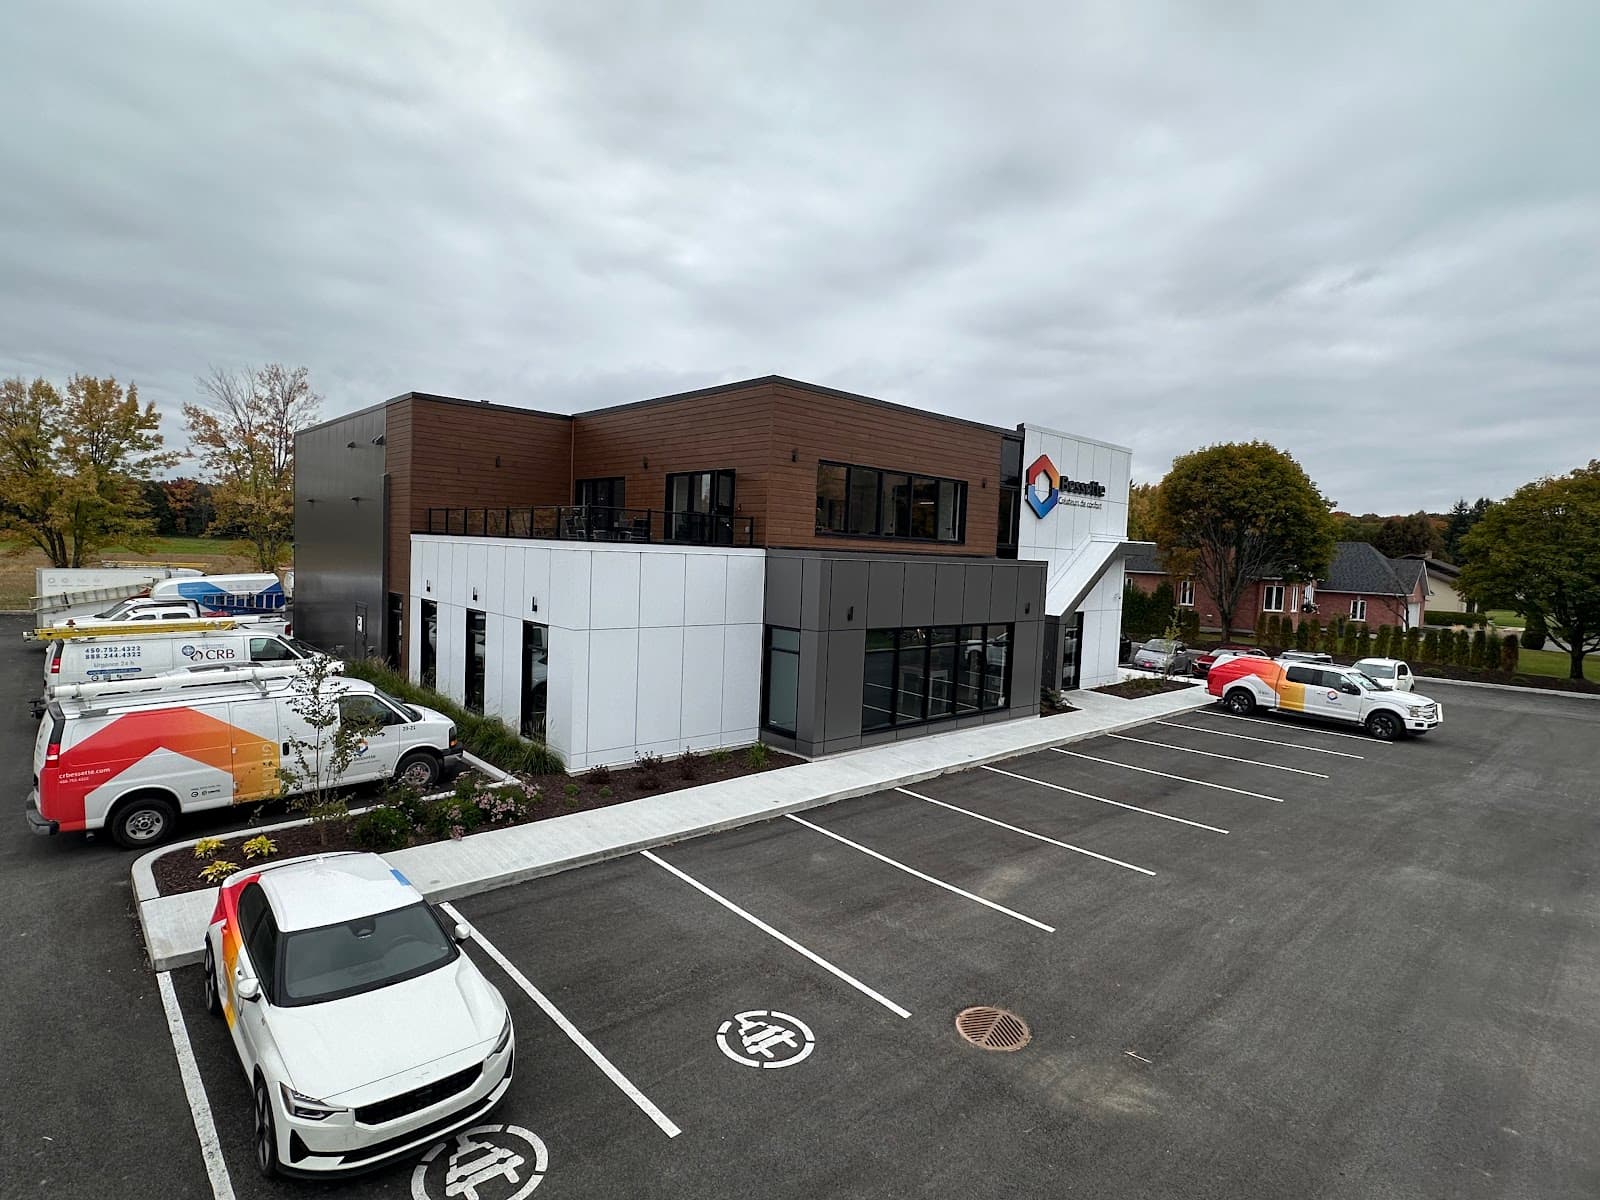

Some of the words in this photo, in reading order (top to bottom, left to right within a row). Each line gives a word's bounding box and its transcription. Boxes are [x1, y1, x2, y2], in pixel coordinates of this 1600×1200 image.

[1060, 475, 1105, 497] Bessette
[85, 646, 141, 654] 450.752.4322
[206, 649, 235, 660] CRB
[85, 652, 141, 660] 888.244.4322
[58, 767, 110, 779] crbessette.com
